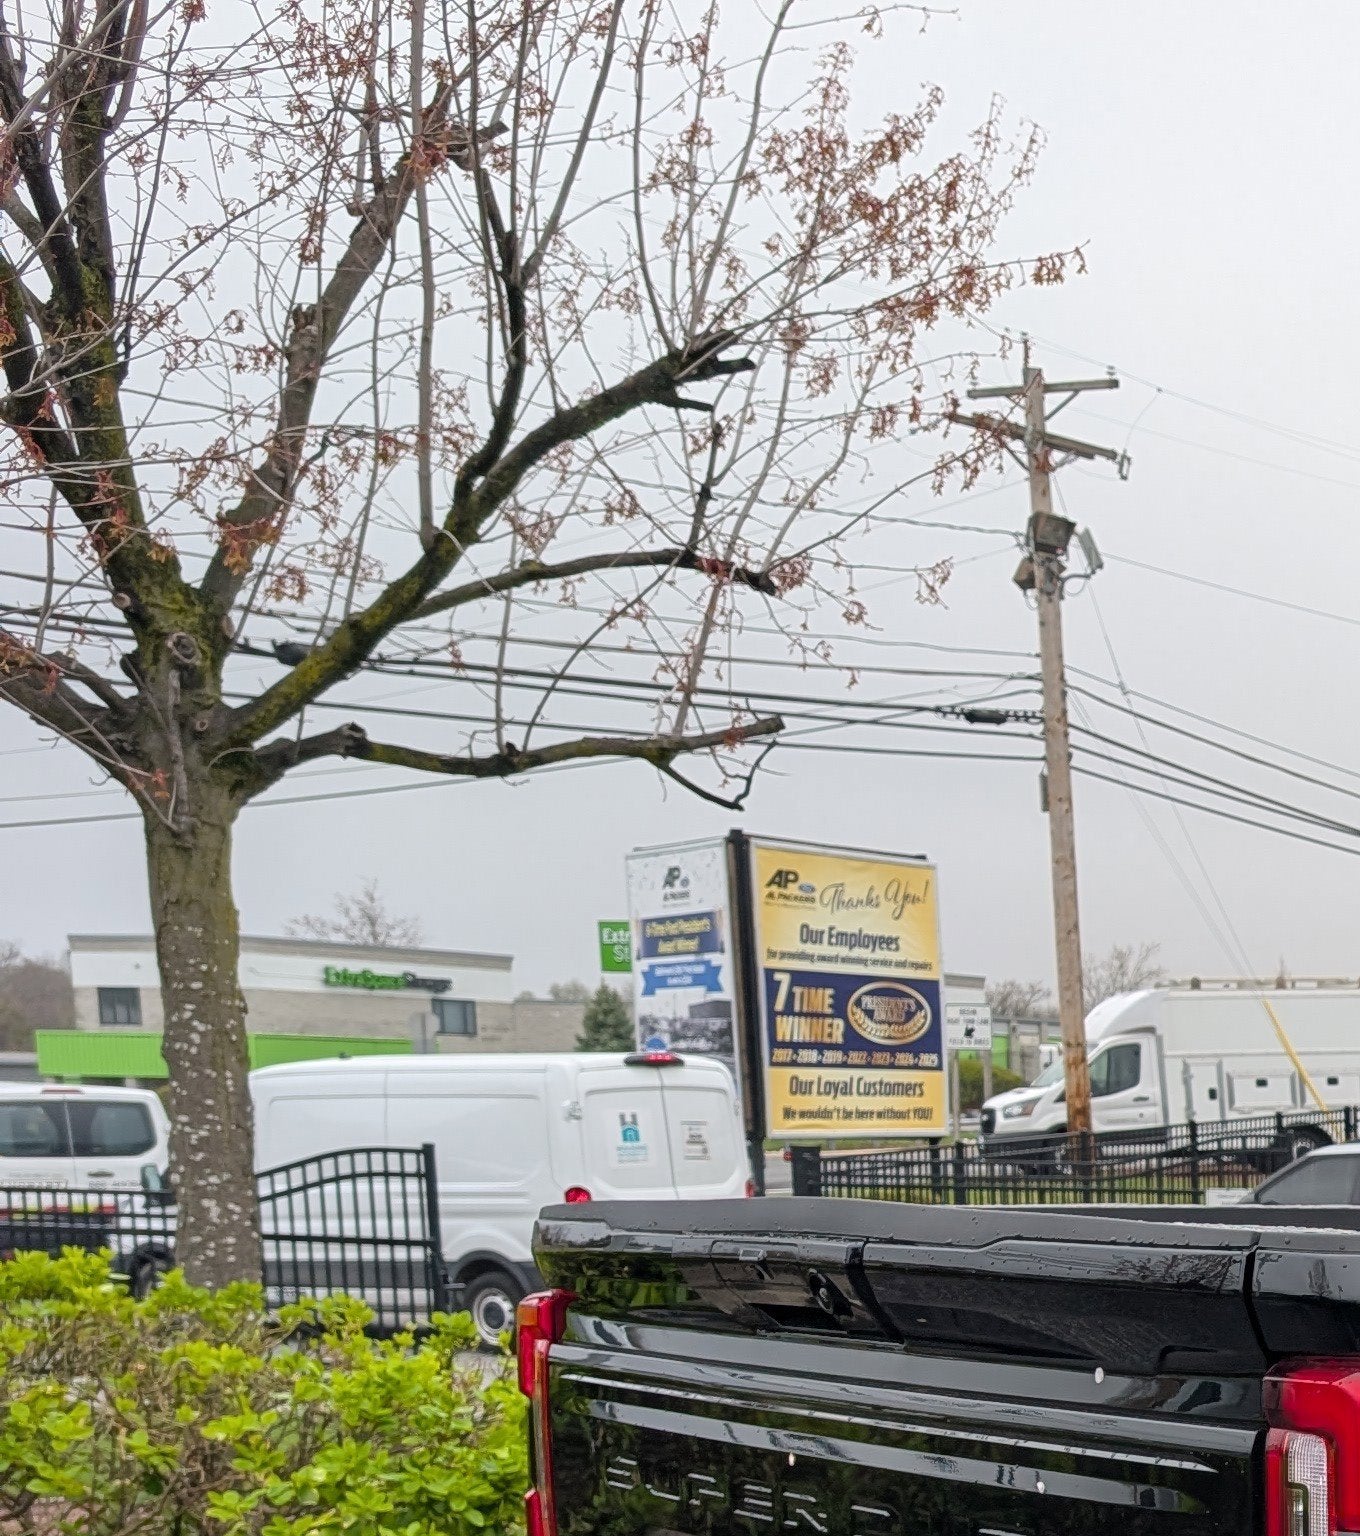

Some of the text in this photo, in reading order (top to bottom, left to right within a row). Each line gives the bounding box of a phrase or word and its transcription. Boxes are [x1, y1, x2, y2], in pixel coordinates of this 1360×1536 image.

[765, 868, 799, 888] AP
[820, 878, 929, 920] Thanks You!
[800, 922, 900, 952] Our Employees
[773, 972, 834, 1014] 7 TIME
[775, 1015, 844, 1044] WINNER
[789, 1075, 924, 1099] Our Loyal Customers
[783, 1107, 797, 1119] We
[798, 1107, 841, 1120] wouldn't
[842, 1107, 853, 1119] be
[855, 1107, 874, 1119] here
[876, 1107, 911, 1120] without
[606, 1455, 829, 1532] SUPER
